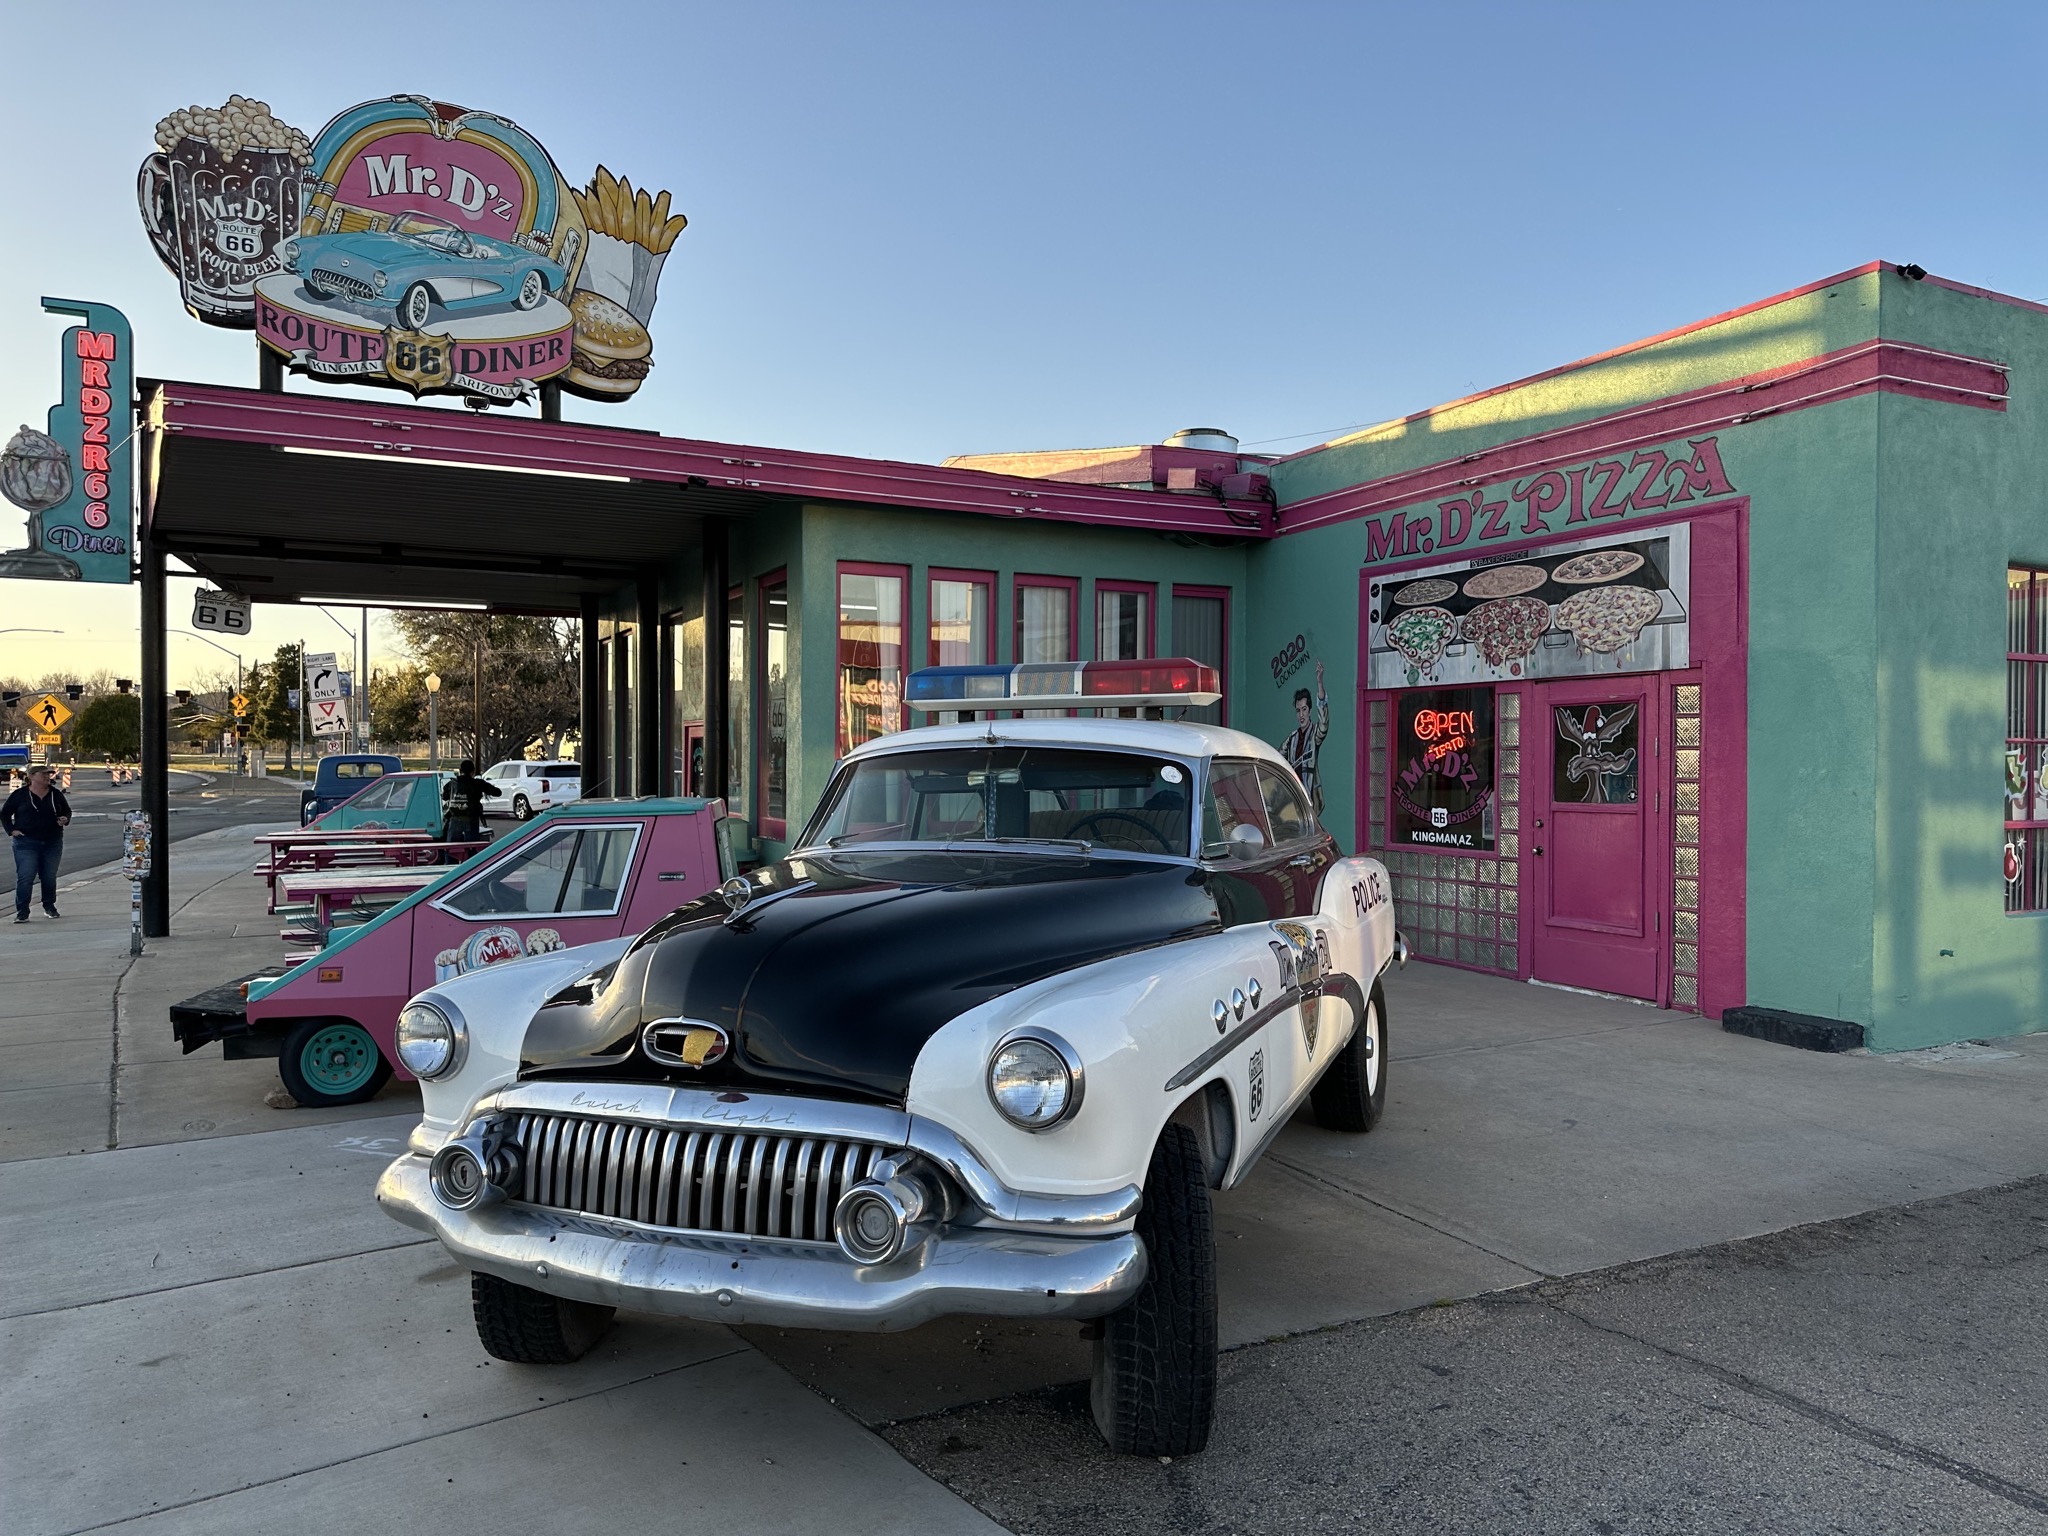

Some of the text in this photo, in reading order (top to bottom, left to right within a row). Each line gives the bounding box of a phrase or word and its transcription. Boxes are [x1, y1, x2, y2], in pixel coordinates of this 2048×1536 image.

[222, 223, 257, 234] ROUTE
[226, 236, 254, 253] 66
[200, 247, 281, 276] ROOT BEER
[262, 304, 564, 375] ROUTE 66 DINER
[311, 360, 522, 398] KINGMAN ARIZONA
[1512, 436, 1739, 533] PIZZA
[48, 524, 125, 554] Diner
[199, 606, 244, 628] 66
[1271, 634, 1306, 679] 2020
[1275, 650, 1311, 689] LOCKDOWN
[315, 689, 336, 698] ONLY
[1414, 709, 1475, 741] OPEN
[1401, 798, 1429, 820] ROUTE
[1433, 812, 1446, 824] 66
[1450, 804, 1482, 823] DINER
[1352, 872, 1382, 917] POLICE
[569, 1090, 798, 1126] Buick Eight
[1251, 1077, 1262, 1115] 66
